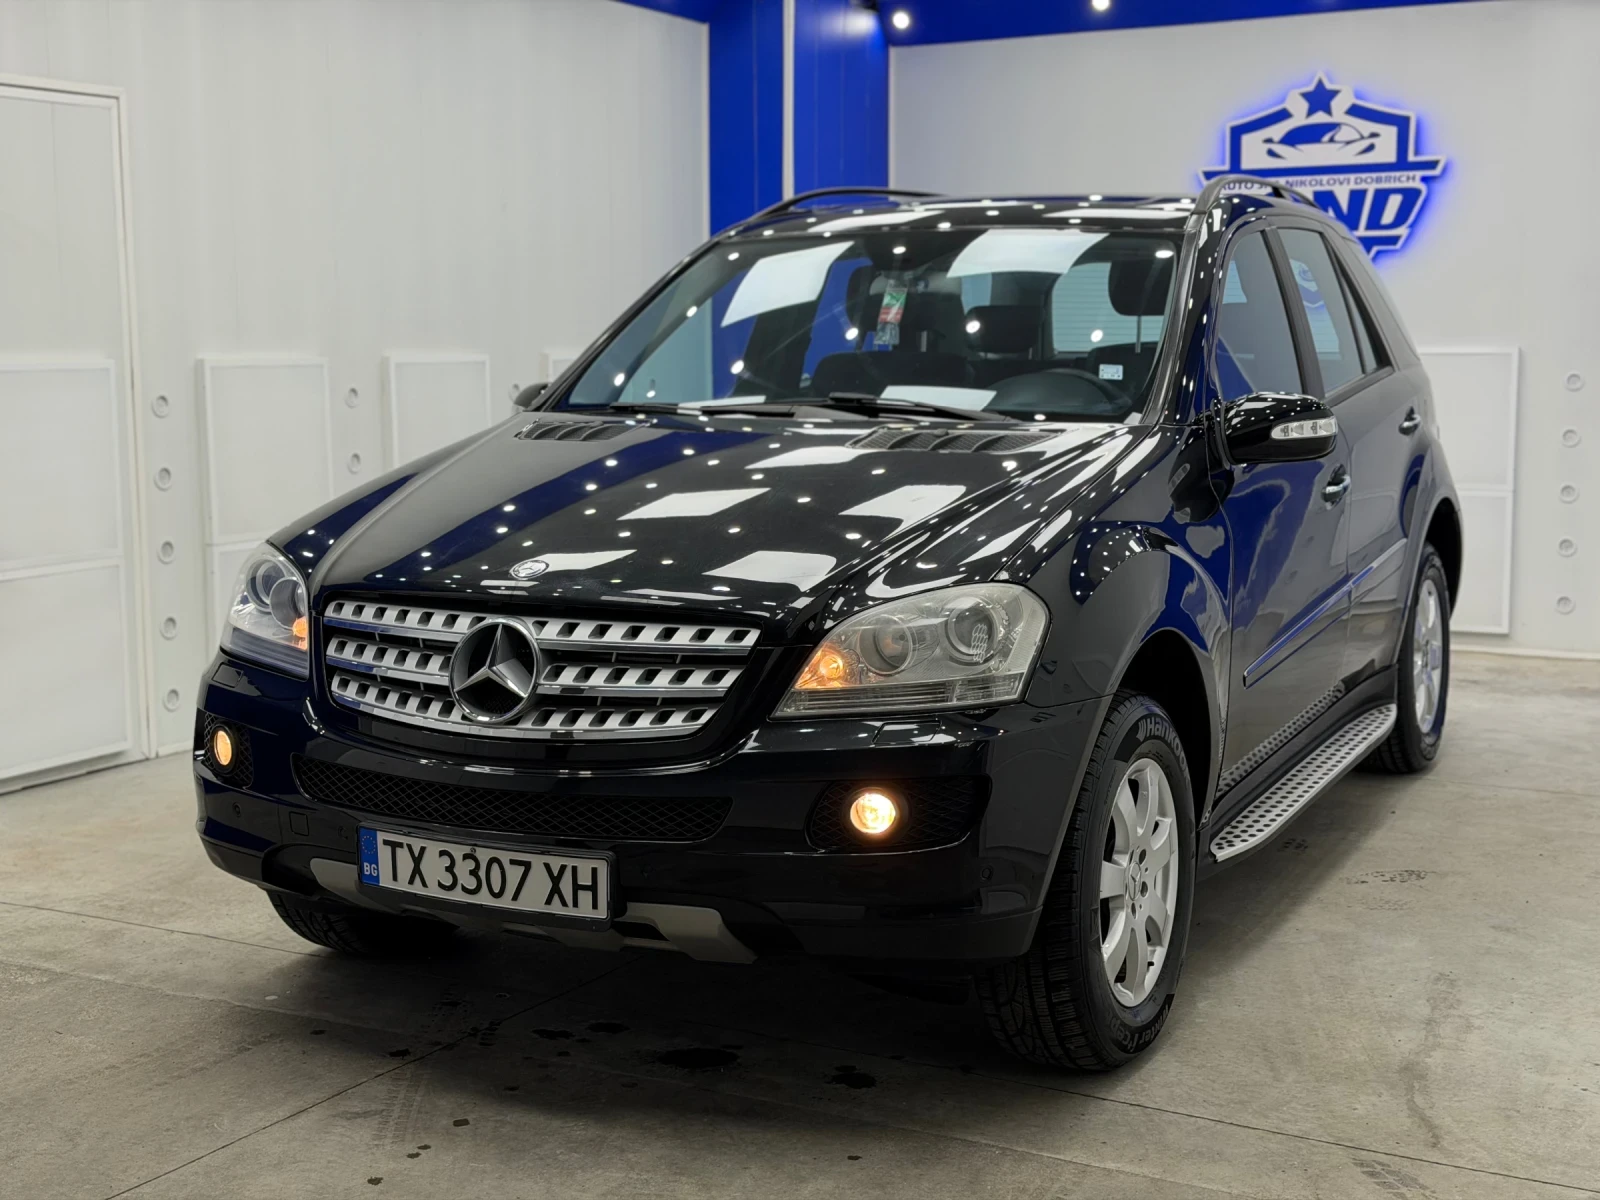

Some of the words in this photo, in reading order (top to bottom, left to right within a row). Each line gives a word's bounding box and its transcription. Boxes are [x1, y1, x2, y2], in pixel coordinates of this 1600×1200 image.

[1286, 176, 1350, 189] NIKOLOVI
[1354, 174, 1417, 186] DOBRICH
[364, 862, 378, 876] BG
[382, 838, 429, 889] TX
[437, 850, 532, 902] 3307
[543, 862, 598, 910] XH
